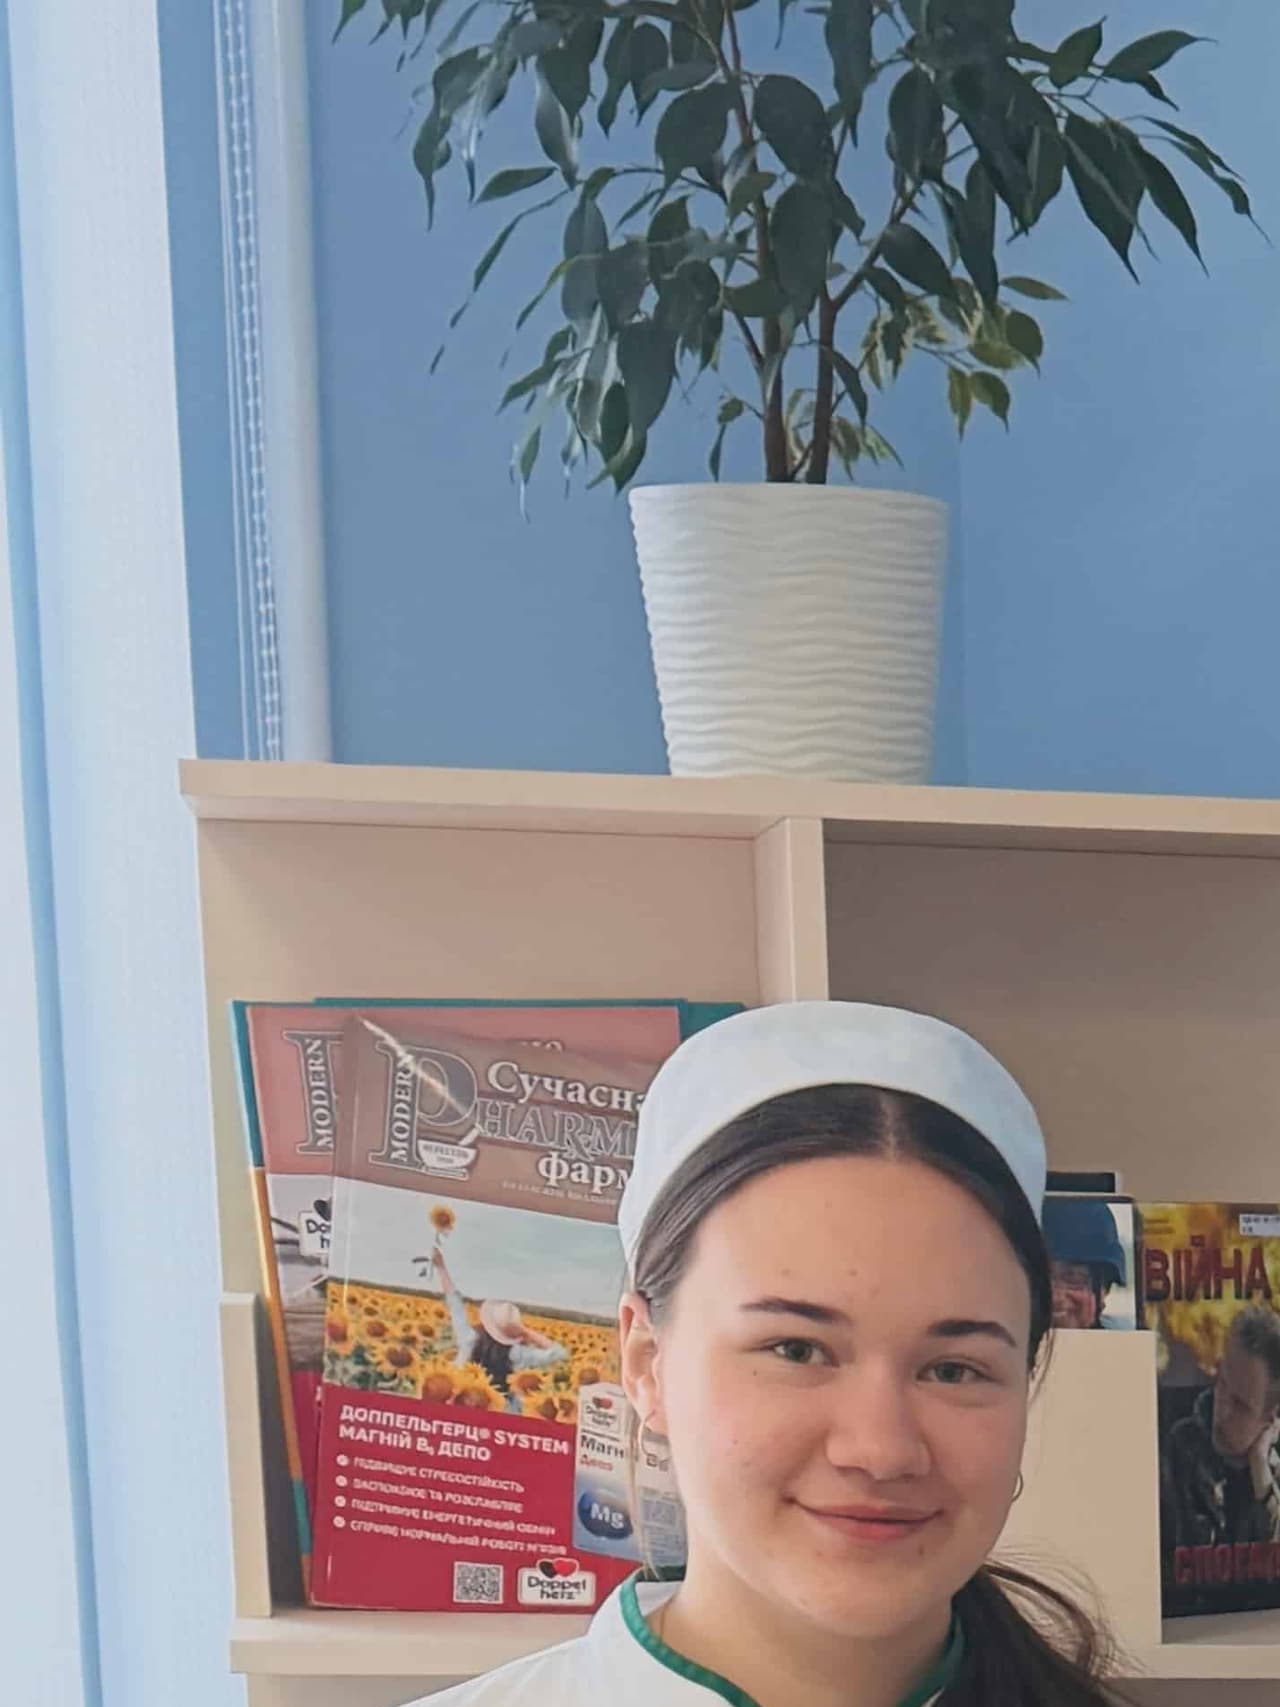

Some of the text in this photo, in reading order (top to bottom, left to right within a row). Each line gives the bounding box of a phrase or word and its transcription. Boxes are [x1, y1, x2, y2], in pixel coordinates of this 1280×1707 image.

[389, 1052, 416, 1163] MODERN
[487, 1060, 646, 1112] Сучасн
[1144, 1234, 1273, 1301] ВІЙНА
[339, 1424, 491, 1462] МАГНІЙ ДЕПО
[494, 1430, 569, 1455] SYSTEM
[590, 1502, 625, 1530] Mg
